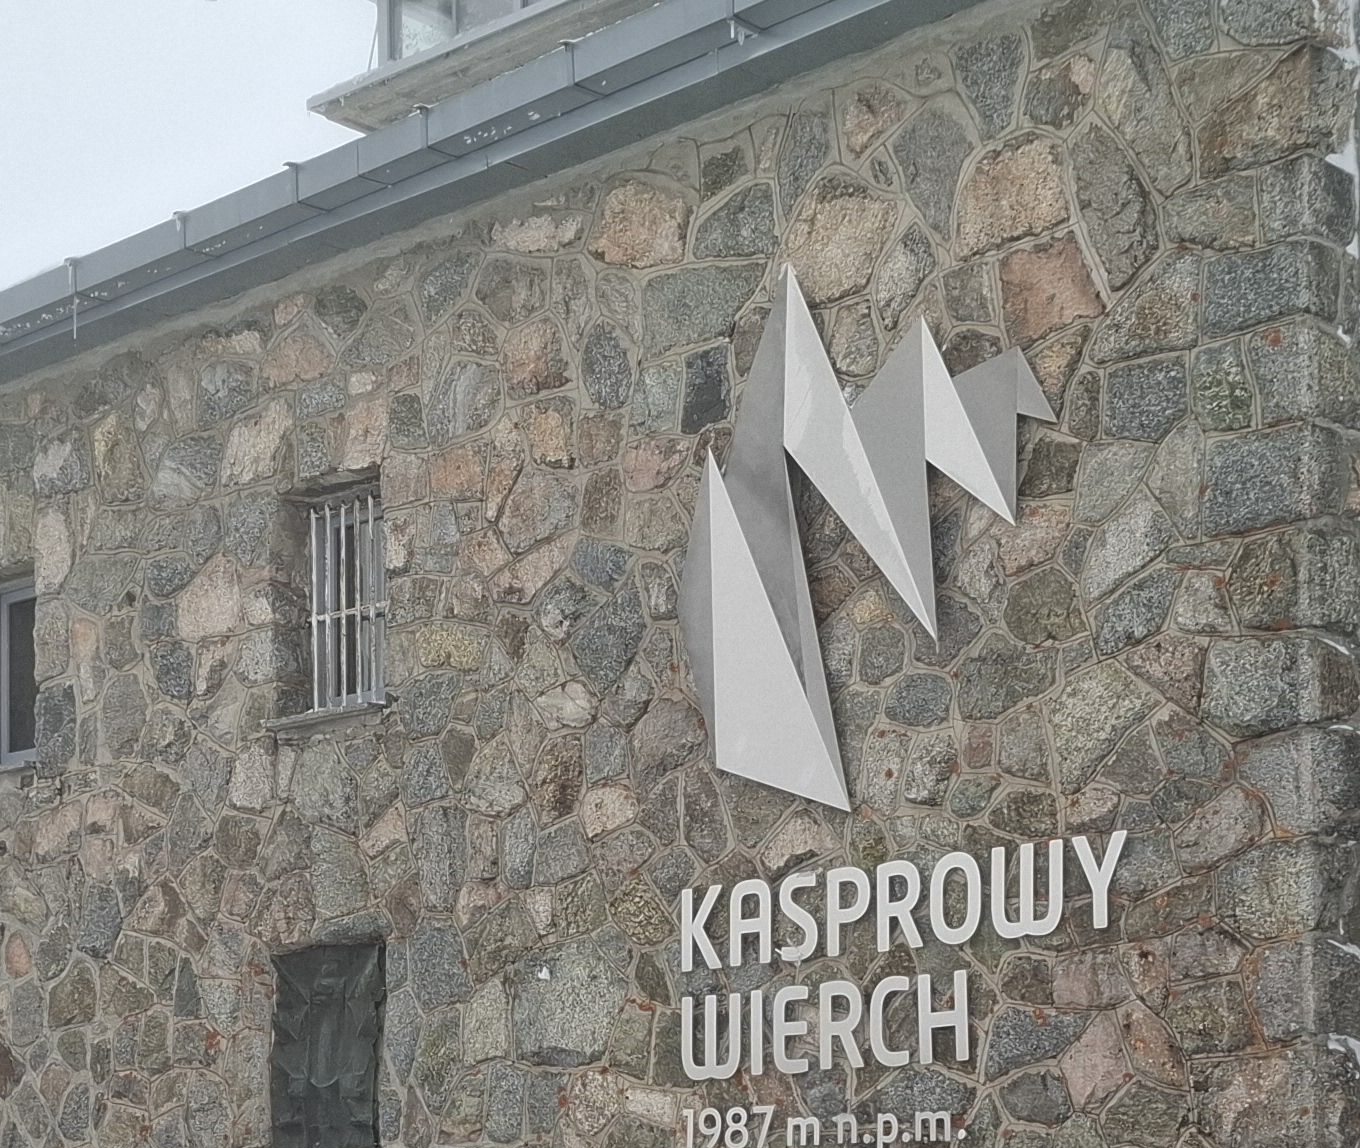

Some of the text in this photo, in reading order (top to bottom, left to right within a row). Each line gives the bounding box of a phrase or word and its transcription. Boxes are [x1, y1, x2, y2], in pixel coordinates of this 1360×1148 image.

[680, 830, 1128, 973] KASPROWY
[680, 969, 970, 1081] WIERCH
[786, 1115, 820, 1147] m
